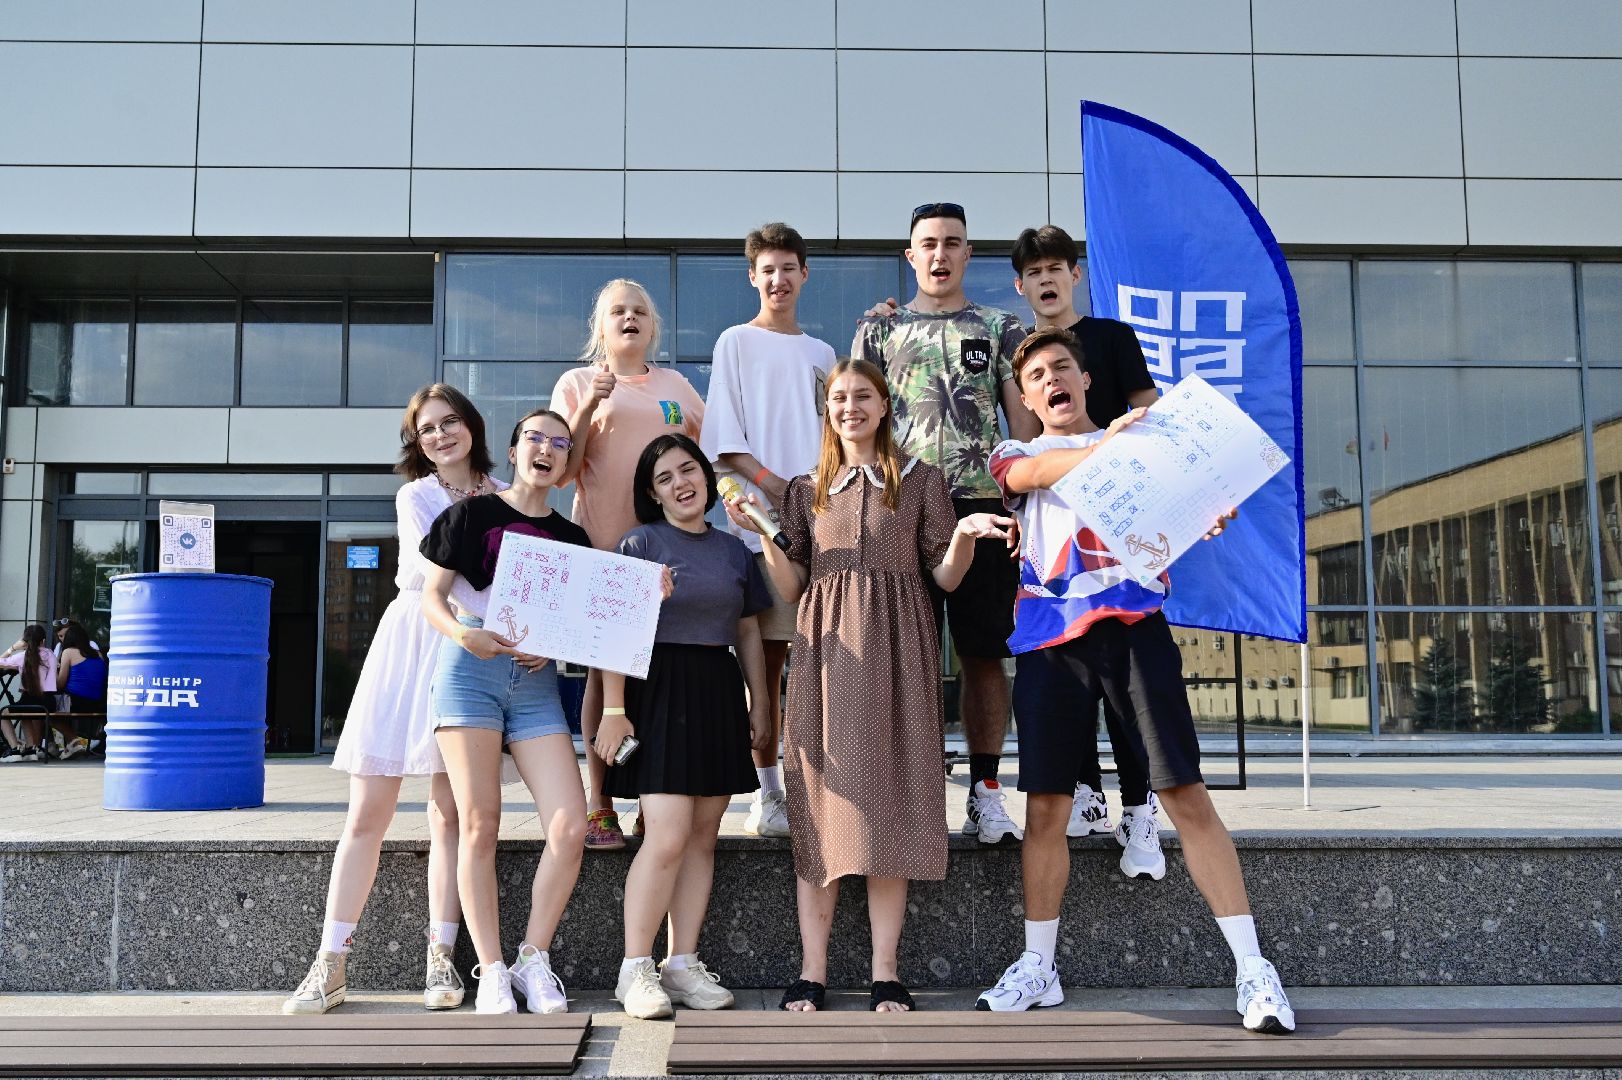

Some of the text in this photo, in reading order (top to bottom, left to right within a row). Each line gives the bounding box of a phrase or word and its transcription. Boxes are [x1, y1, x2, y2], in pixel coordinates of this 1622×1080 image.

[965, 350, 987, 362] ULTRA
[109, 675, 202, 687] ЕЖНЫЙ ЦЕНТР
[107, 688, 199, 708] БЕДА
